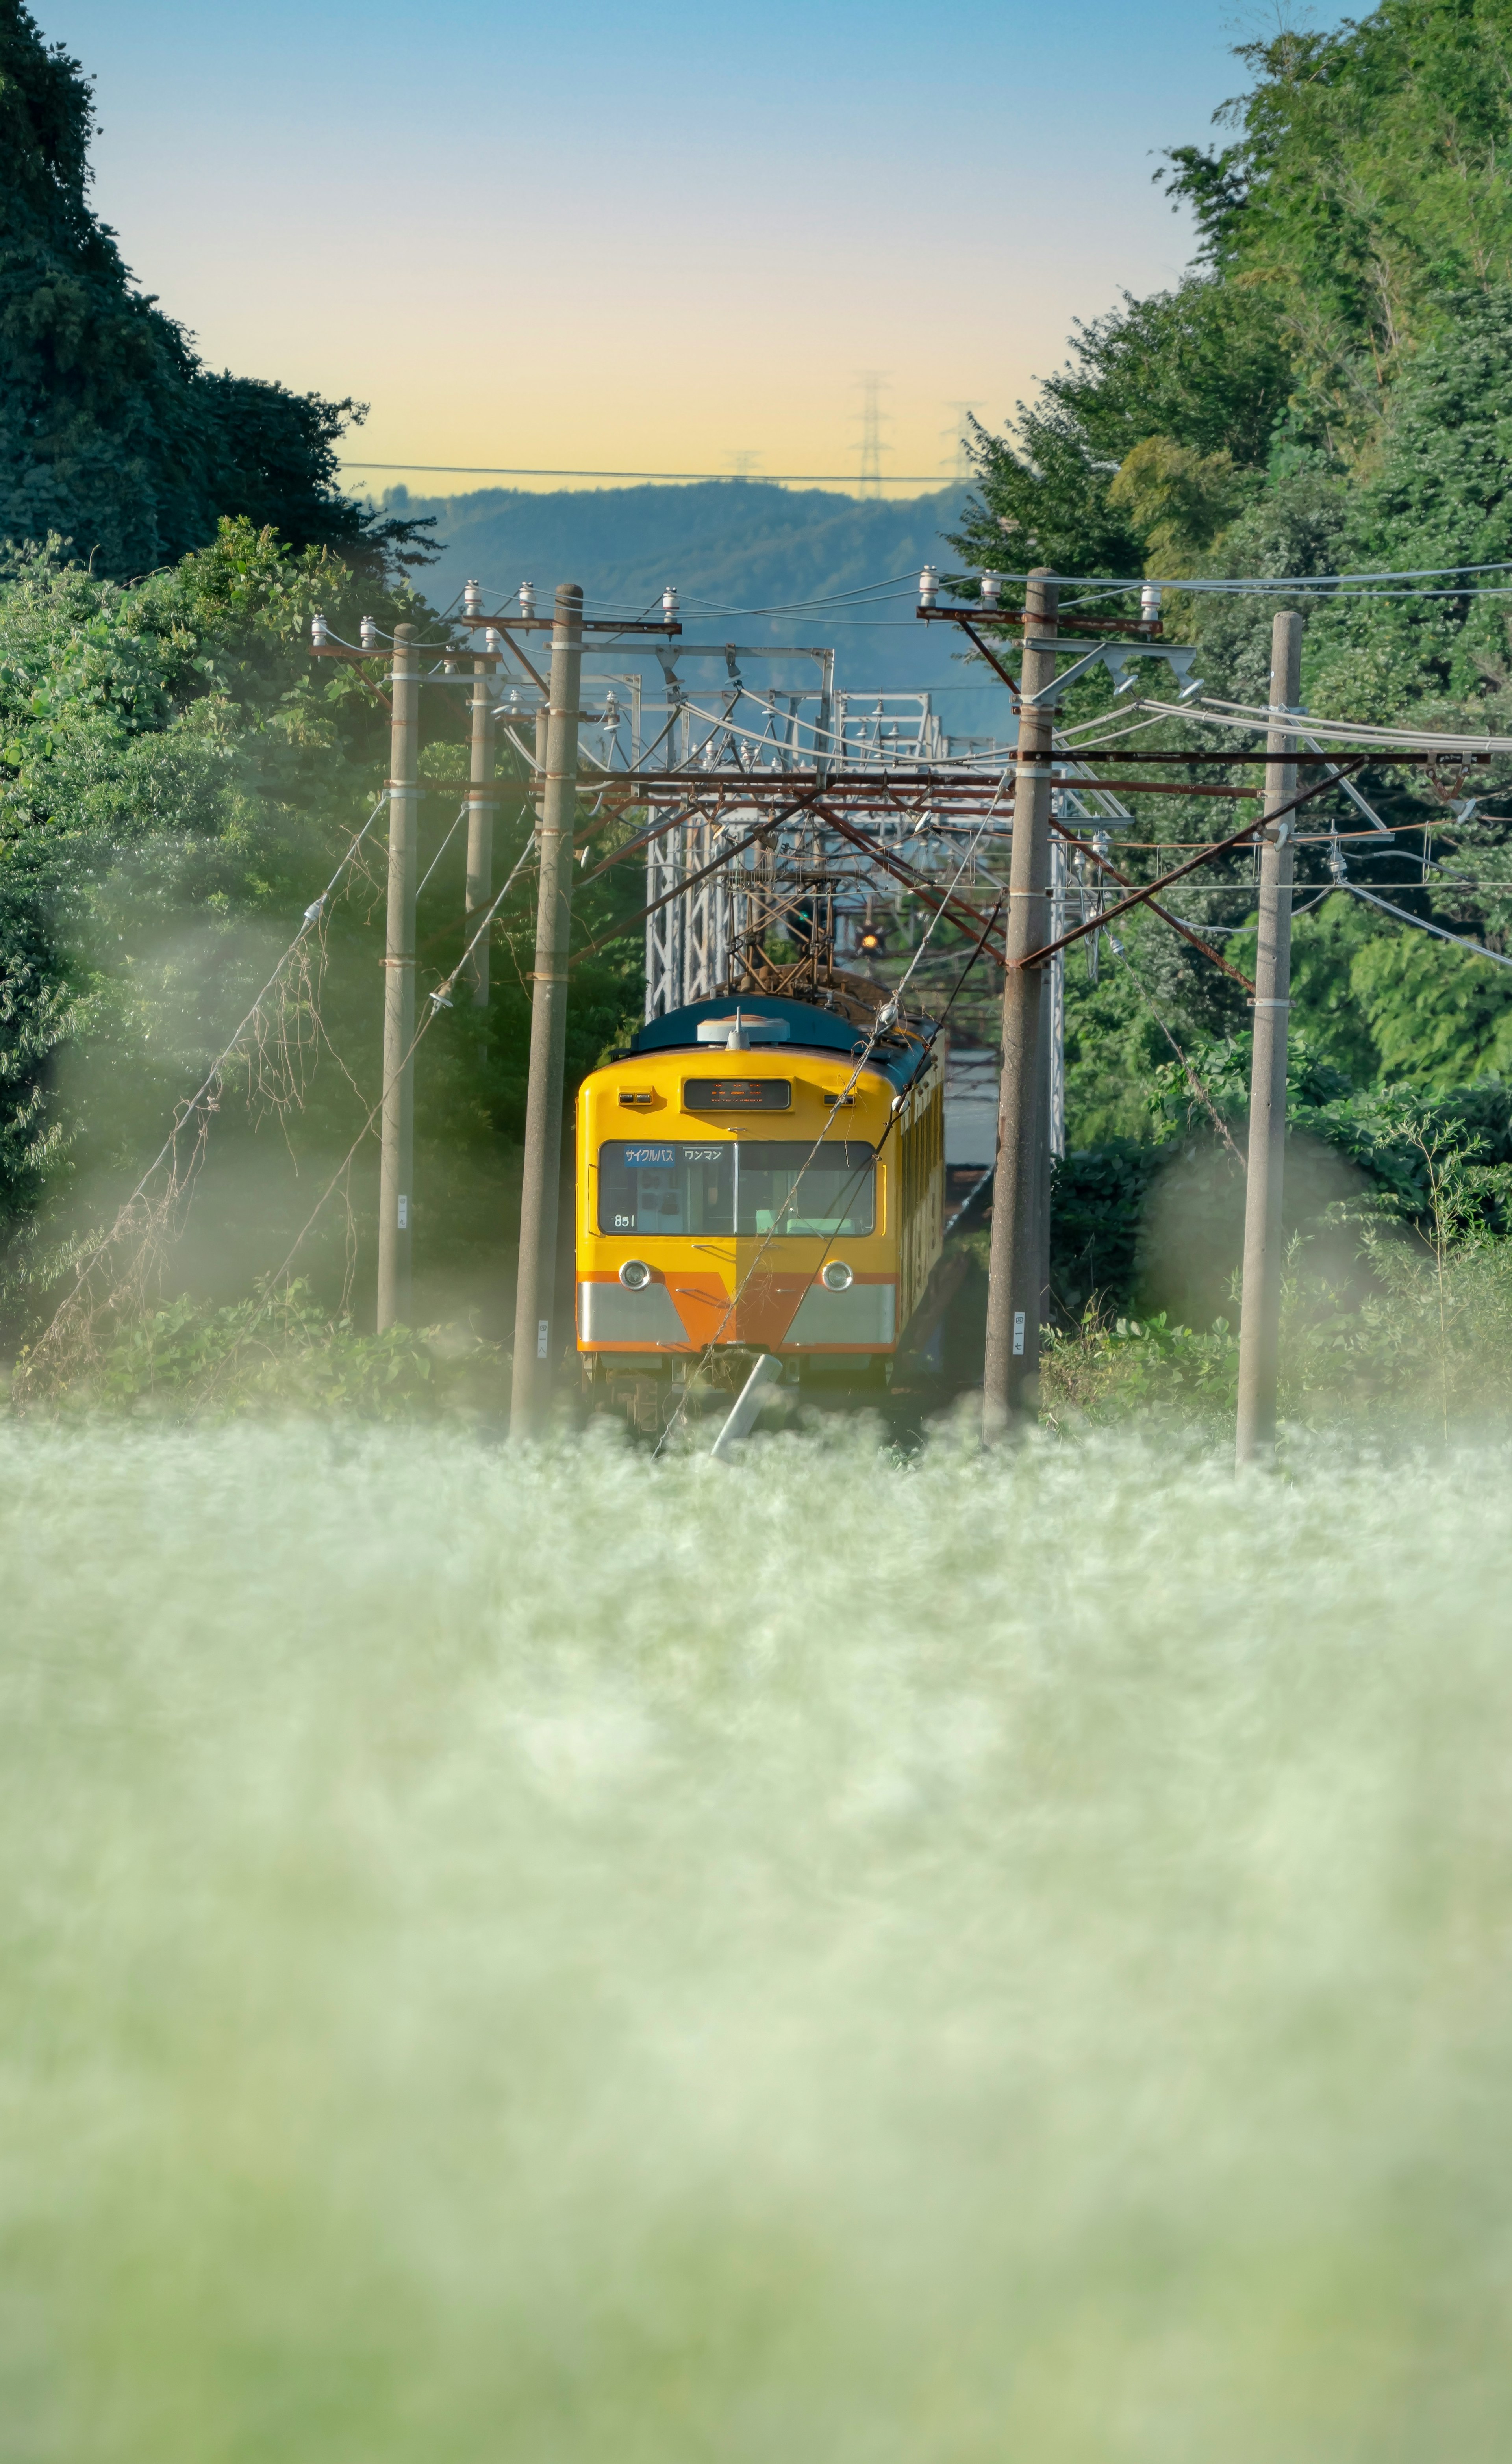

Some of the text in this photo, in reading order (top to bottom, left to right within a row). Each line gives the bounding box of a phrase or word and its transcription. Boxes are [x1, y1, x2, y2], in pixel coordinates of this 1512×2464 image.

[626, 1149, 673, 1161] サイクルパス
[684, 1151, 721, 1160] ワンマン
[615, 1214, 634, 1227] 851
[1014, 1317, 1024, 1350] 四一七
